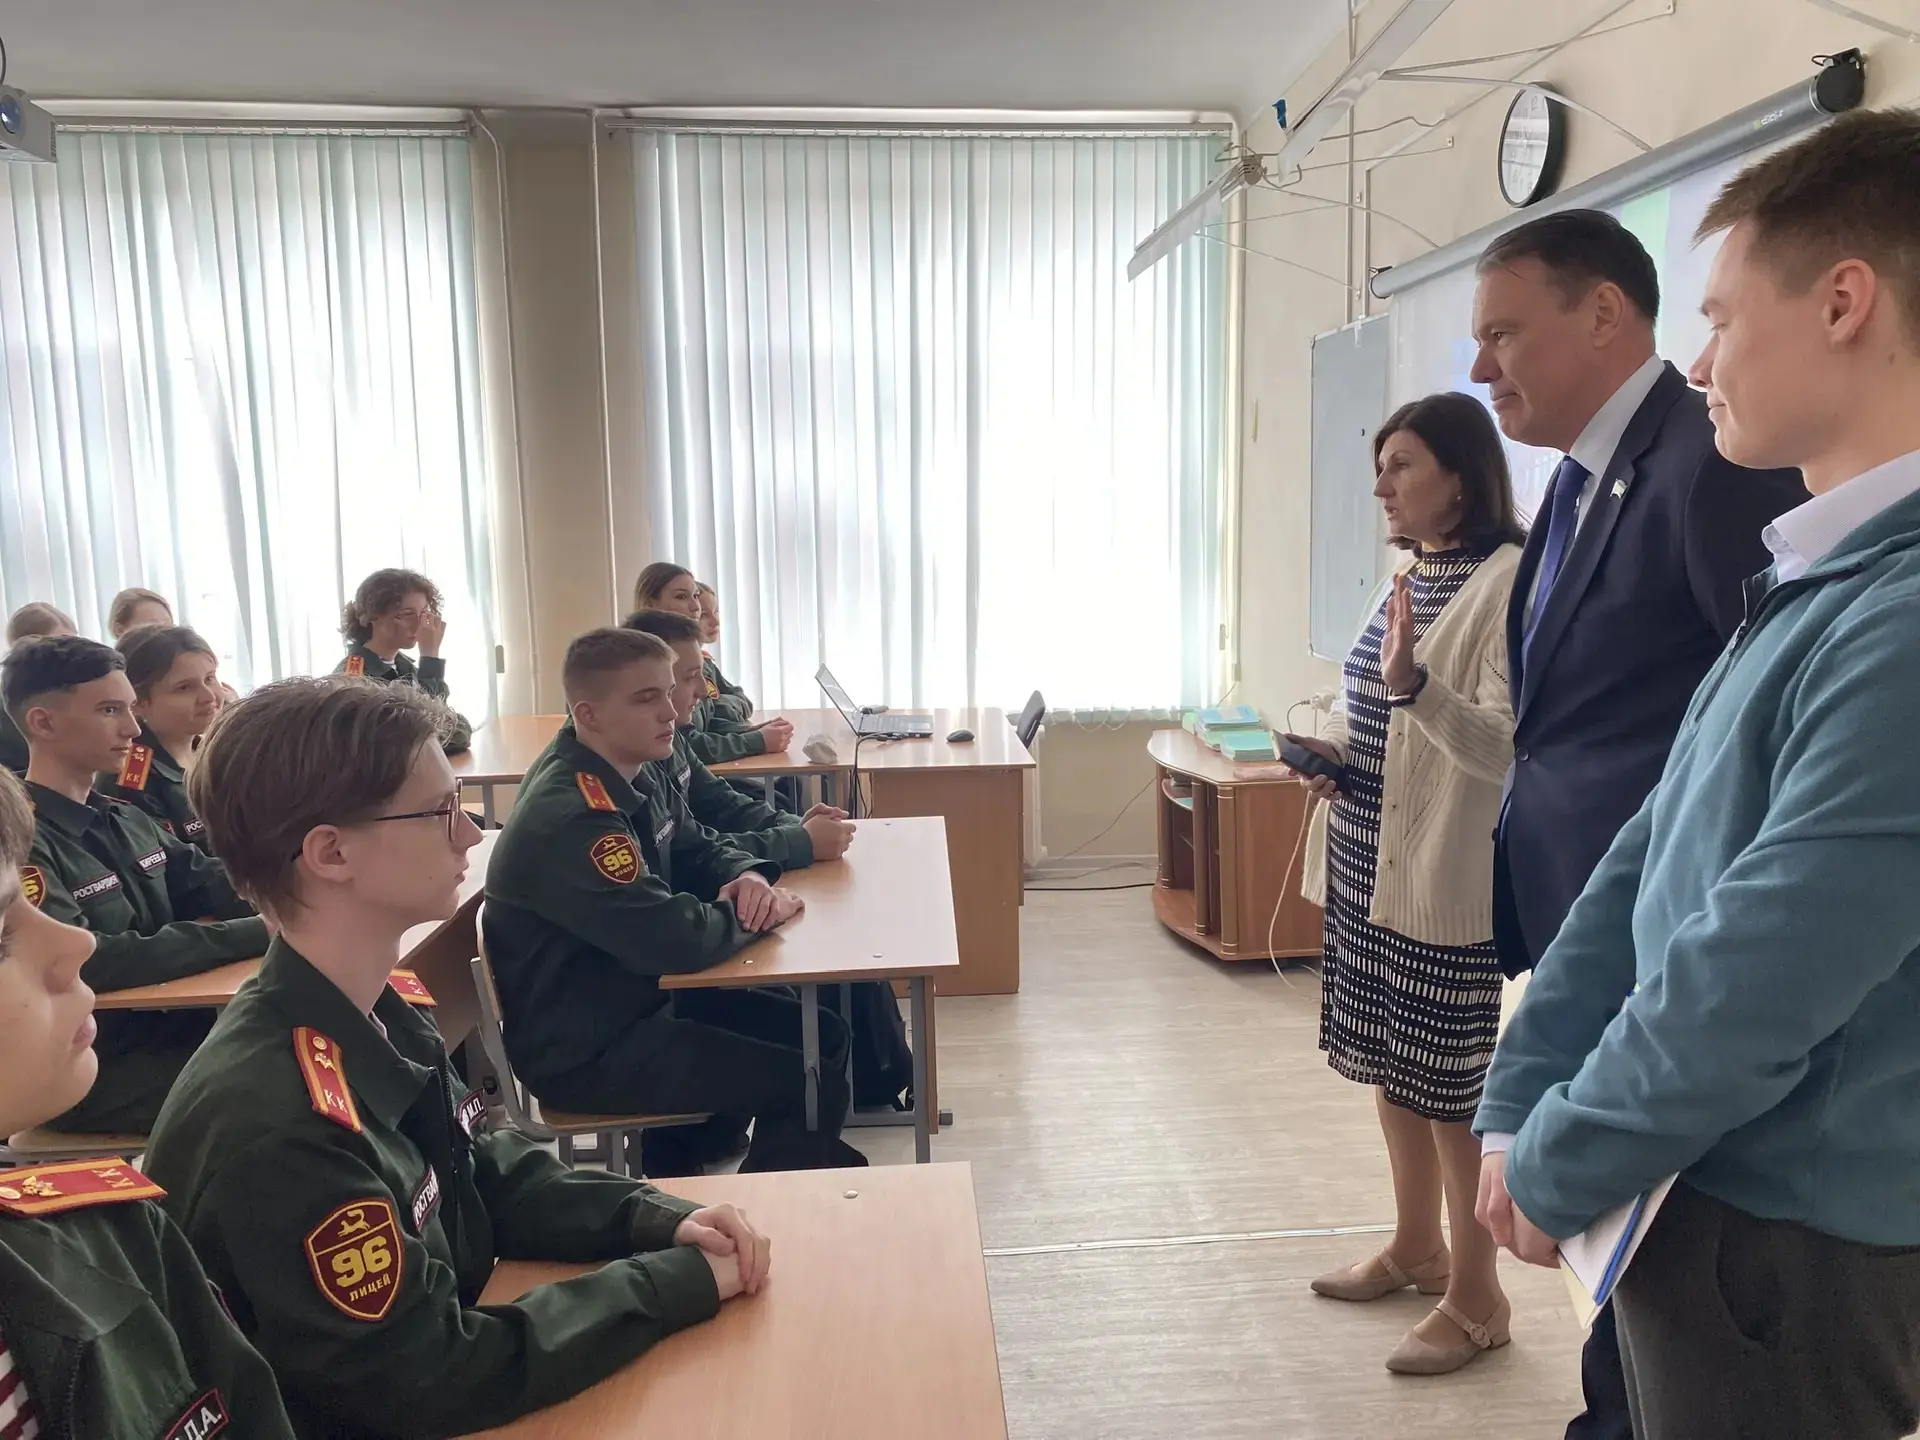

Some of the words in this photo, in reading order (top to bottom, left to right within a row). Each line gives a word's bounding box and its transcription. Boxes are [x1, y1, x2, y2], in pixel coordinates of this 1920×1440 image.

[603, 849, 633, 872] 96
[331, 1235, 392, 1288] 96
[349, 1272, 391, 1302] ЛИЦЕЙ
